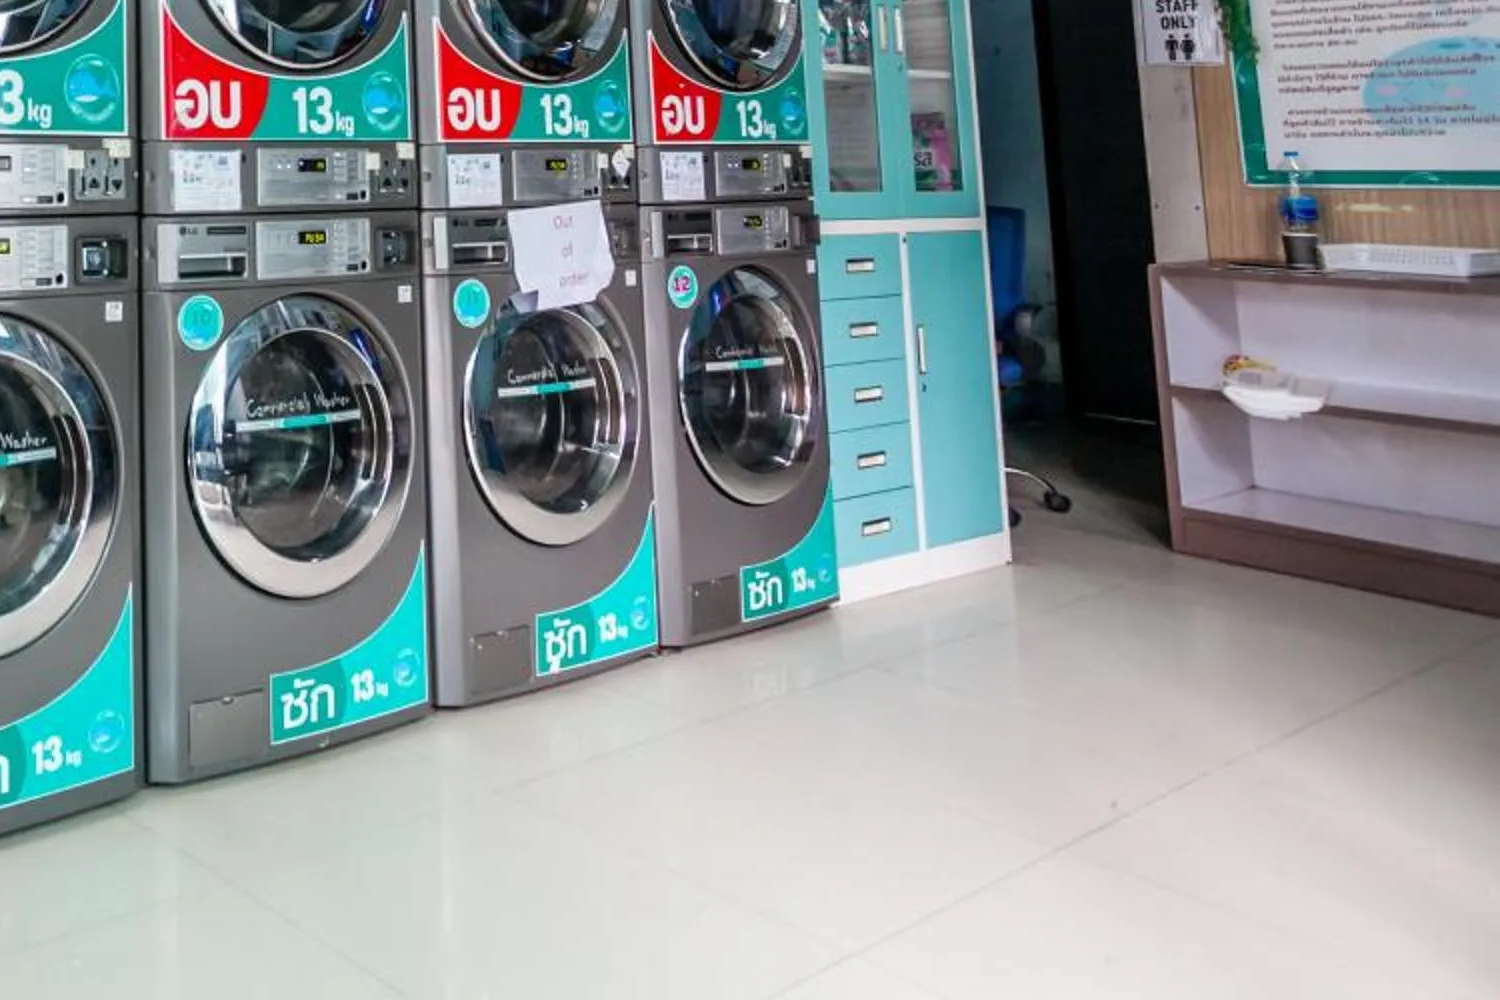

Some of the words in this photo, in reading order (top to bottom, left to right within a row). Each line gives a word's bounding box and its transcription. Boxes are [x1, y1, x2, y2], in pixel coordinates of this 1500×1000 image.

[1160, 15, 1195, 30] ONLY
[28, 101, 53, 129] kg
[174, 78, 242, 130] อบ
[292, 86, 334, 135] 13
[336, 115, 355, 137] kg
[448, 87, 501, 132] อบ
[540, 94, 573, 136] 13
[574, 116, 590, 138] kg
[662, 95, 705, 135] อบ
[736, 99, 764, 139] 13
[764, 119, 777, 139] kg
[675, 276, 690, 292] 12
[0, 430, 48, 449] Washer
[747, 569, 783, 611] ซัก
[544, 616, 587, 666] ซัก
[280, 677, 335, 730] ซัก
[350, 669, 375, 703] 13
[31, 736, 63, 776] 13
